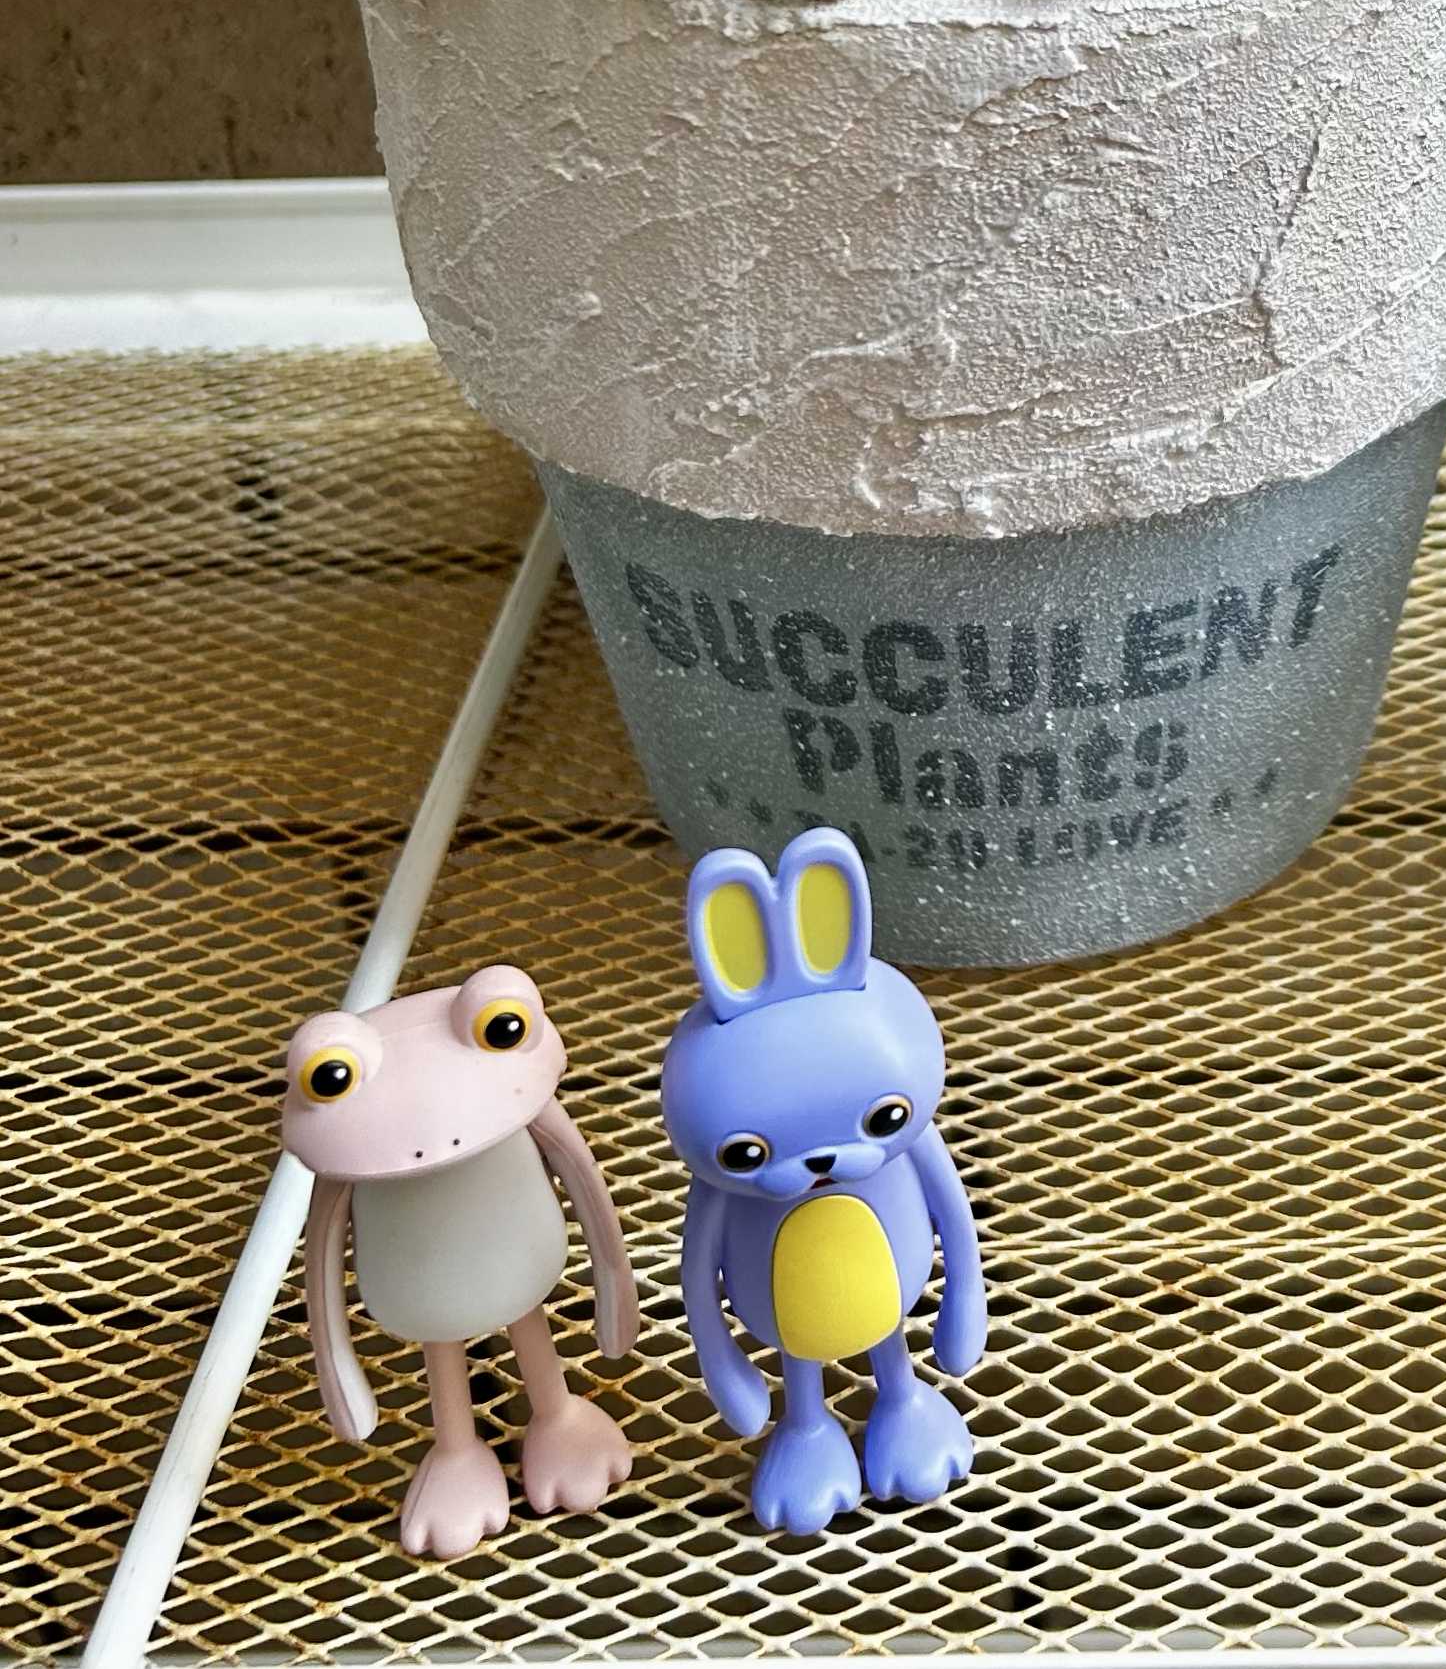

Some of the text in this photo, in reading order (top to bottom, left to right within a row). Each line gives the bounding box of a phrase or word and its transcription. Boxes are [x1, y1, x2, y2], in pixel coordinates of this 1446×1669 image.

[625, 543, 1344, 714] SUCCULENT
[783, 708, 1191, 810] Plants
[1016, 798, 1190, 869] LOVE
